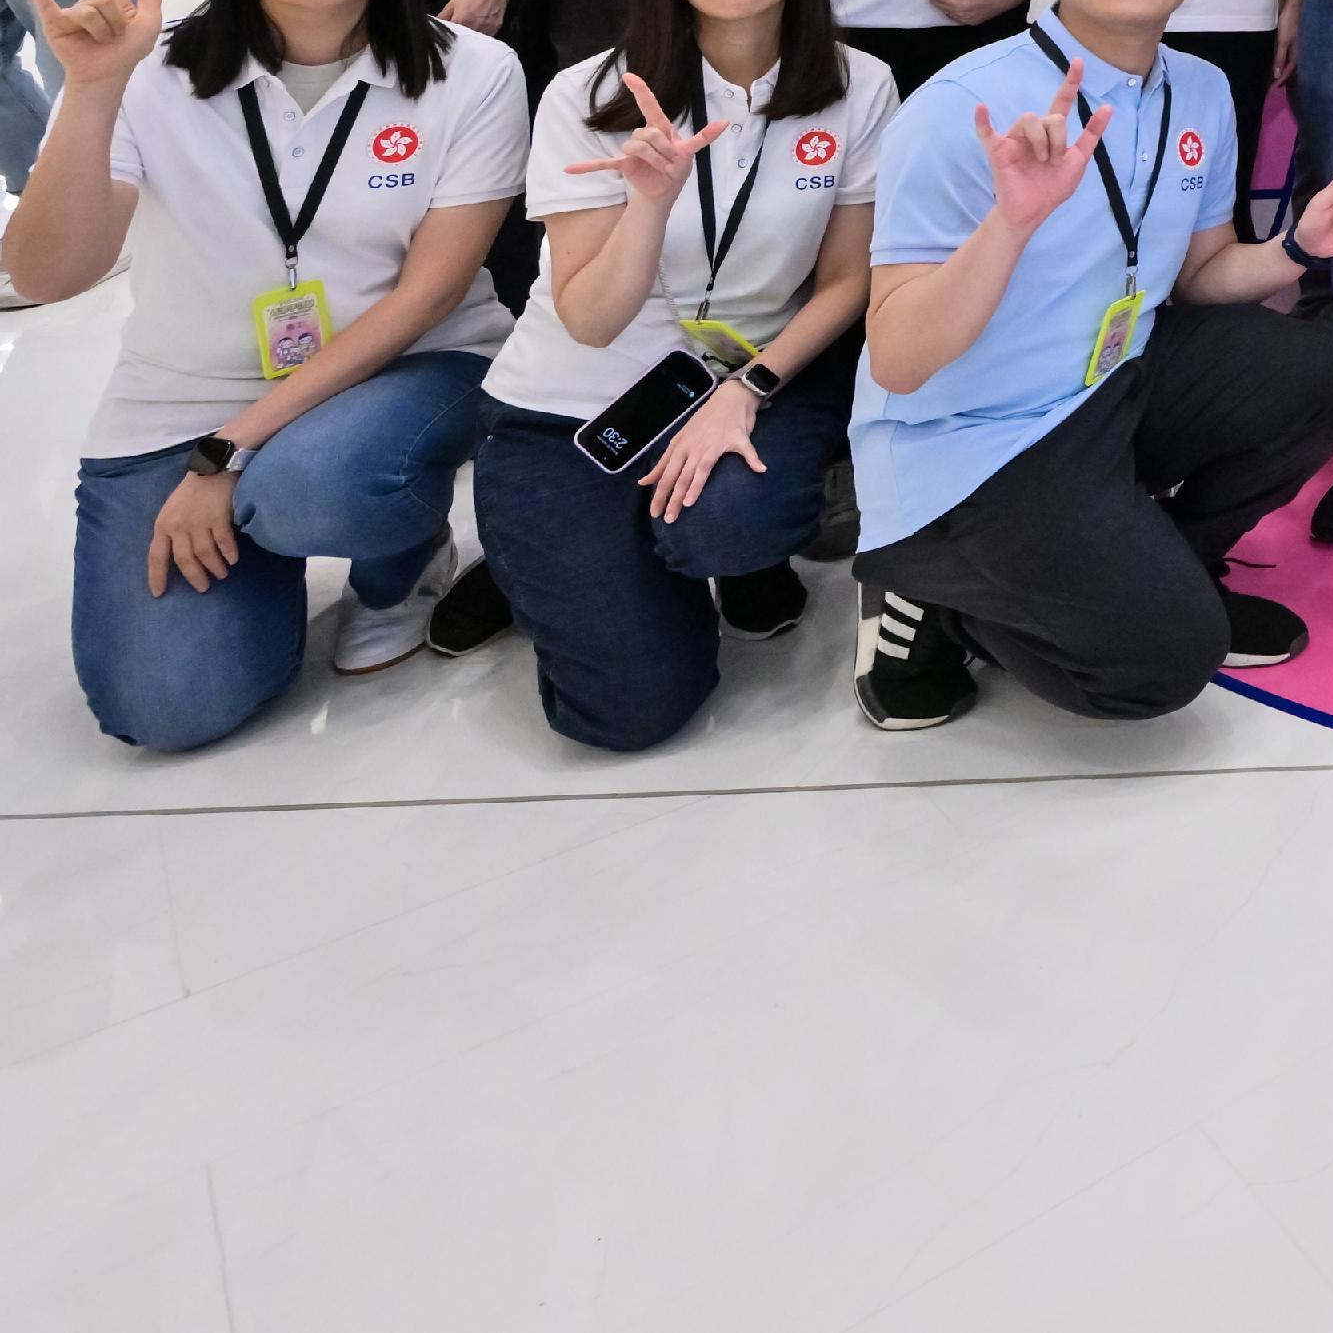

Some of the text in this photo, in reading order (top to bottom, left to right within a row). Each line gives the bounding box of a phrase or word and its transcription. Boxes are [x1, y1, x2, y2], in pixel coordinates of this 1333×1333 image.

[367, 172, 415, 189] CSB
[795, 174, 835, 191] CSB
[1181, 175, 1204, 192] CSB
